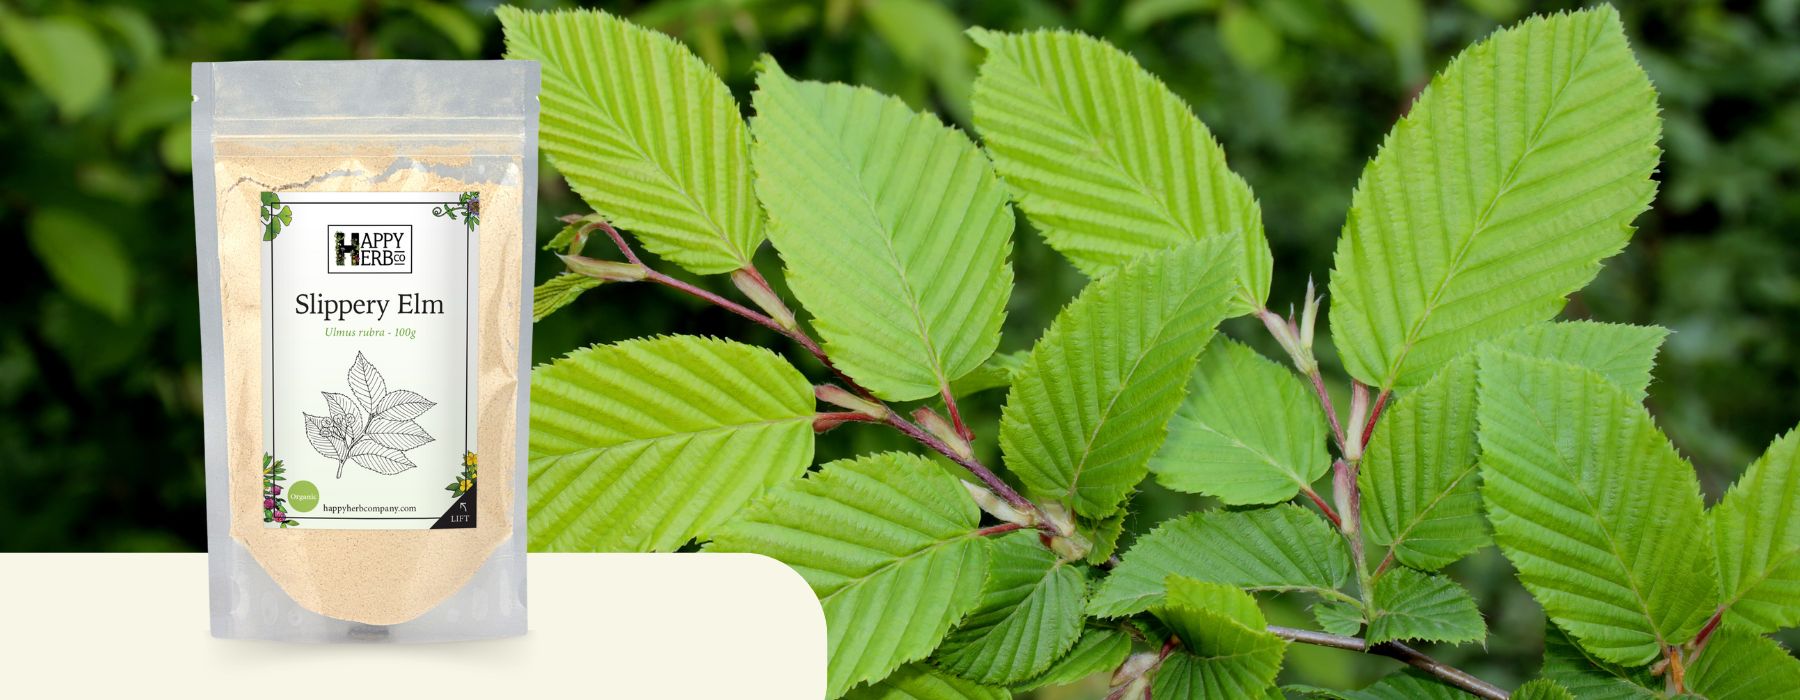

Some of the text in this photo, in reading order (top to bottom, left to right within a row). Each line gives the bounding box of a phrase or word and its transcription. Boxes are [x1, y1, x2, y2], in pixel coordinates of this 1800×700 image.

[334, 231, 404, 266] HAPPY
[296, 293, 444, 321] Slippery Elm
[325, 328, 356, 337] Ulmus
[359, 328, 385, 337] rubra
[395, 328, 416, 338] 100g
[290, 493, 318, 501] Organic
[323, 504, 417, 514] happyherbcompany.com
